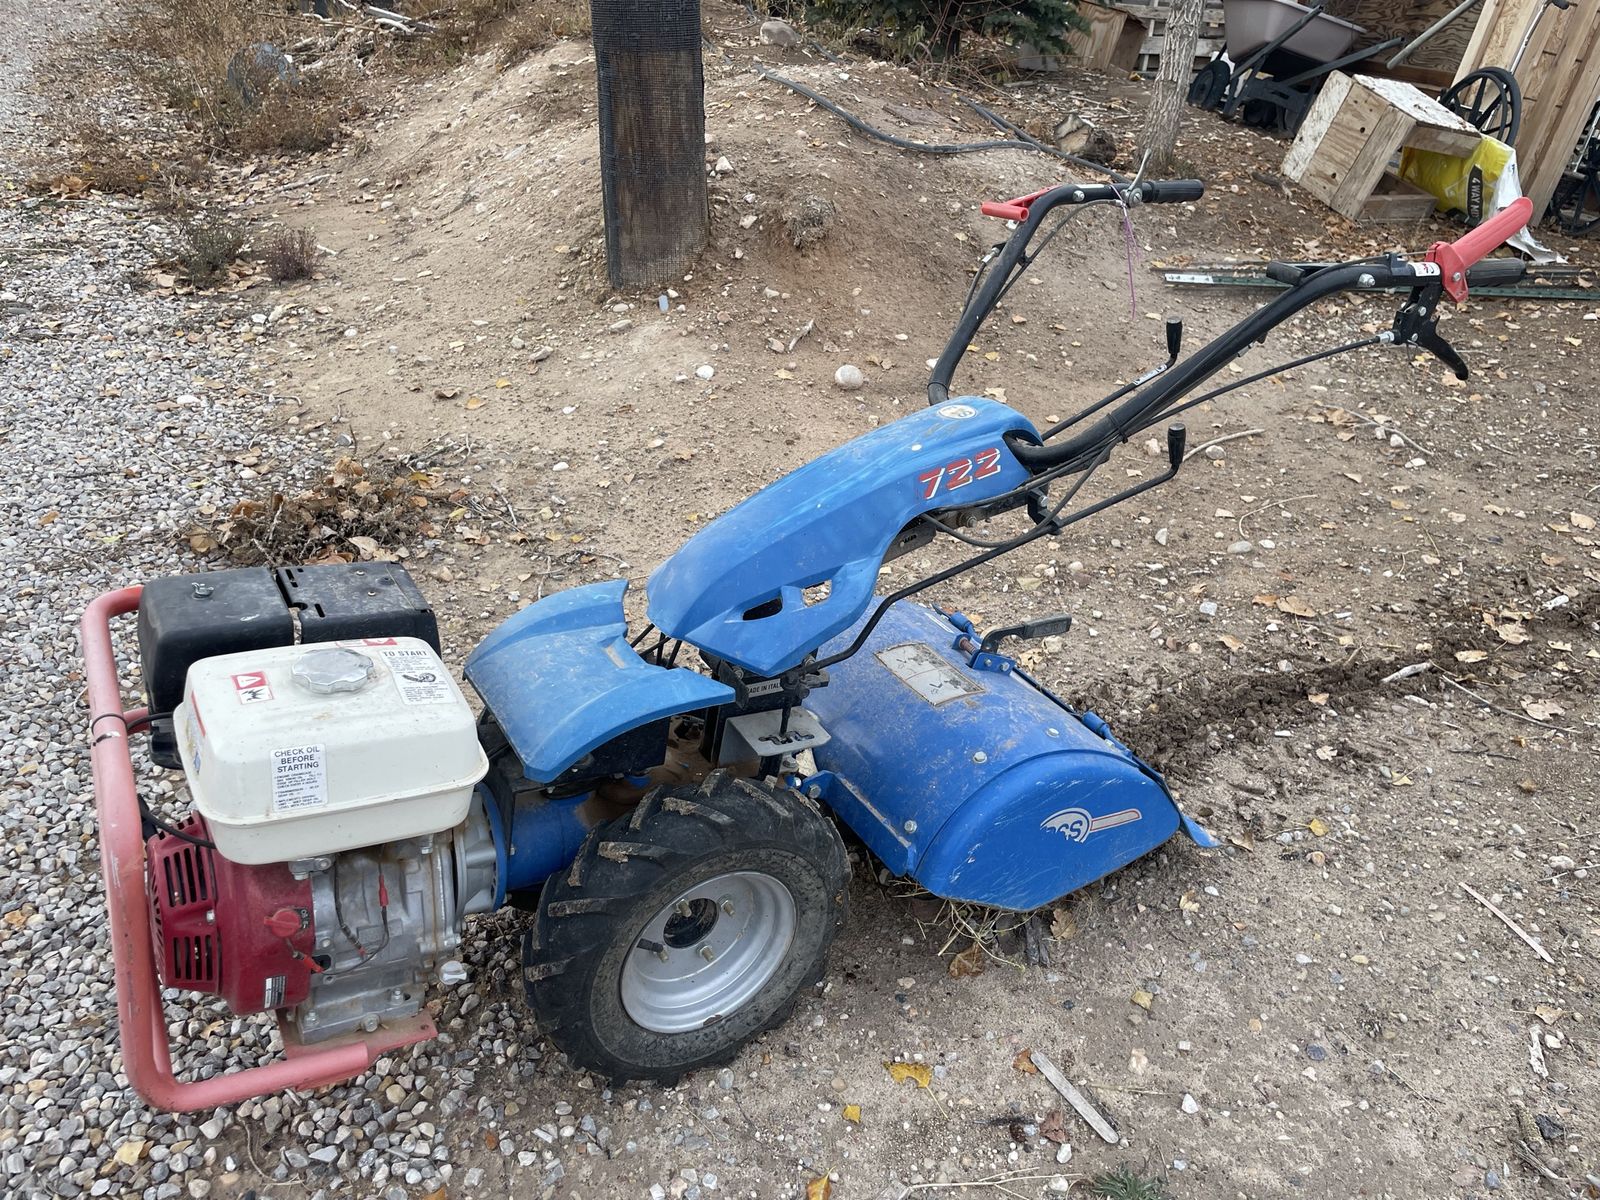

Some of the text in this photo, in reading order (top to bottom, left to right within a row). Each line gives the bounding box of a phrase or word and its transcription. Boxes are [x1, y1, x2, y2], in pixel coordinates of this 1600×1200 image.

[1471, 185, 1481, 203] WAY
[919, 448, 1001, 500] 722
[274, 746, 320, 758] CHECK OIL
[280, 753, 315, 765] BEFORE
[277, 761, 319, 773] STARTING
